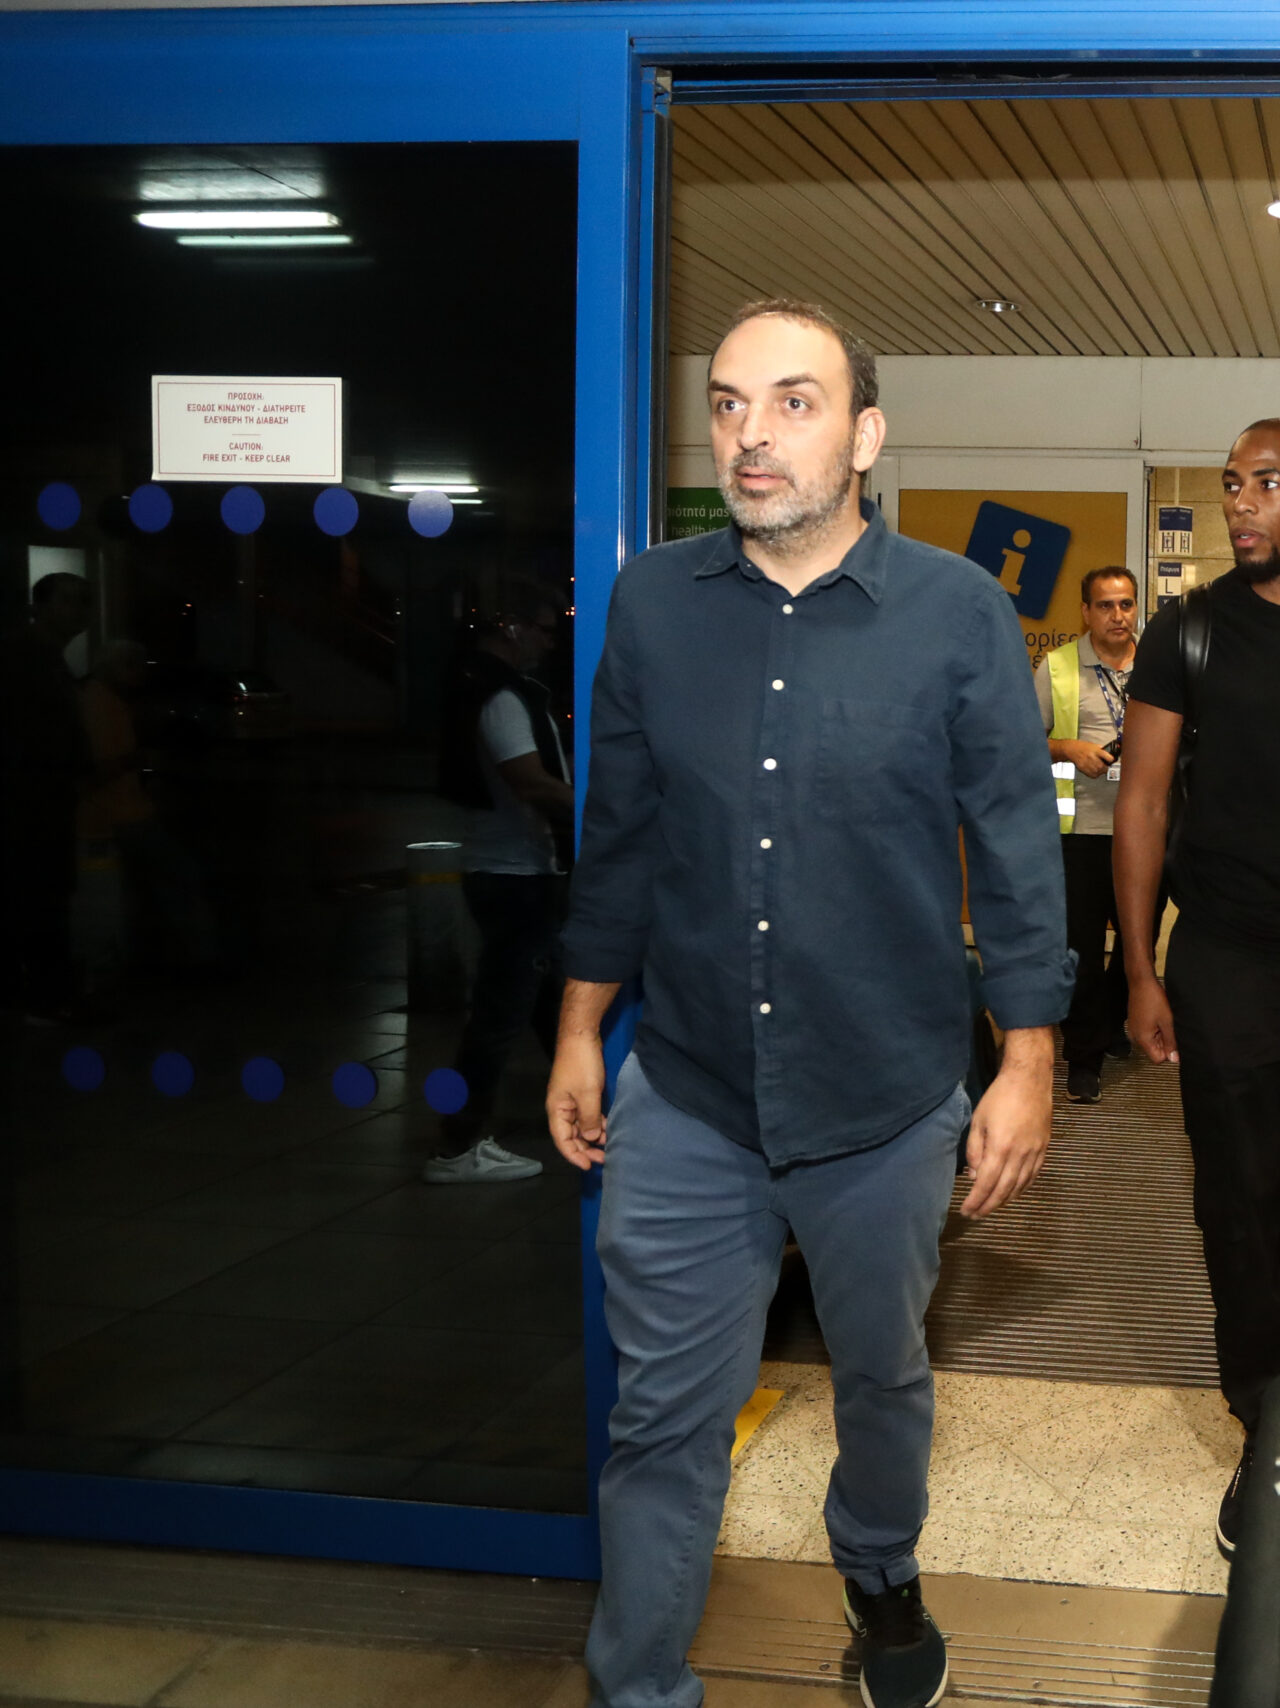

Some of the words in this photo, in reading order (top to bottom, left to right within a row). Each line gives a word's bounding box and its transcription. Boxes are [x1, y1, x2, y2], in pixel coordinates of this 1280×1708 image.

[187, 404, 215, 412] ΕΞΟΔΟΣ
[218, 404, 255, 413] ΚΙΝΔΥΝΟΥ
[263, 405, 306, 413] ΔΙΑΤΗΡΕΙΤΕ
[204, 416, 242, 424] ΕΛΕΥΘΕΡΗ
[245, 416, 254, 424] ΤΗ
[256, 416, 289, 425] ΔΙΑΒΑΣΗ
[203, 454, 219, 462] FIRE
[222, 454, 237, 462] EXIT
[245, 454, 264, 462] KEEP
[266, 455, 291, 463] CLEAR
[1165, 578, 1173, 594] L
